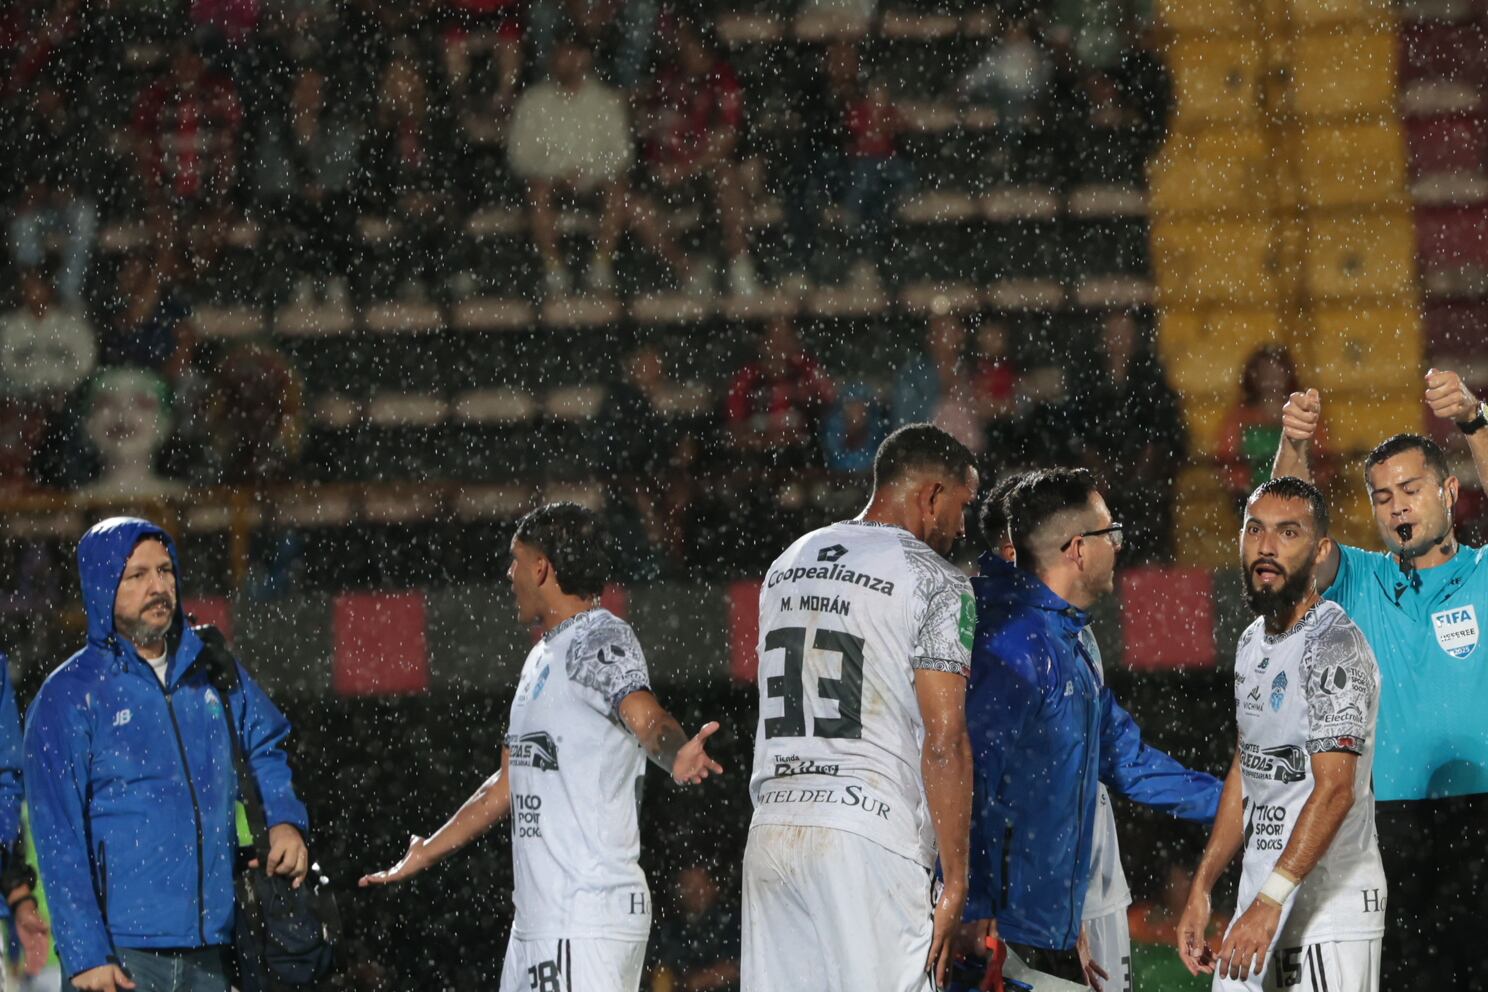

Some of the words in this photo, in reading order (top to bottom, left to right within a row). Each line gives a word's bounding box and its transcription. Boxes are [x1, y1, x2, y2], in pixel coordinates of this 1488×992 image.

[767, 563, 895, 597] Coopealianza
[780, 596, 793, 613] M.
[799, 594, 851, 617] MORÁN
[1436, 609, 1472, 627] FIFA
[764, 626, 865, 740] 33
[800, 789, 839, 804] DEL
[840, 785, 892, 821] SUR
[1256, 805, 1287, 822] TICO
[1255, 823, 1285, 836] SPORT
[1273, 946, 1303, 989] 15
